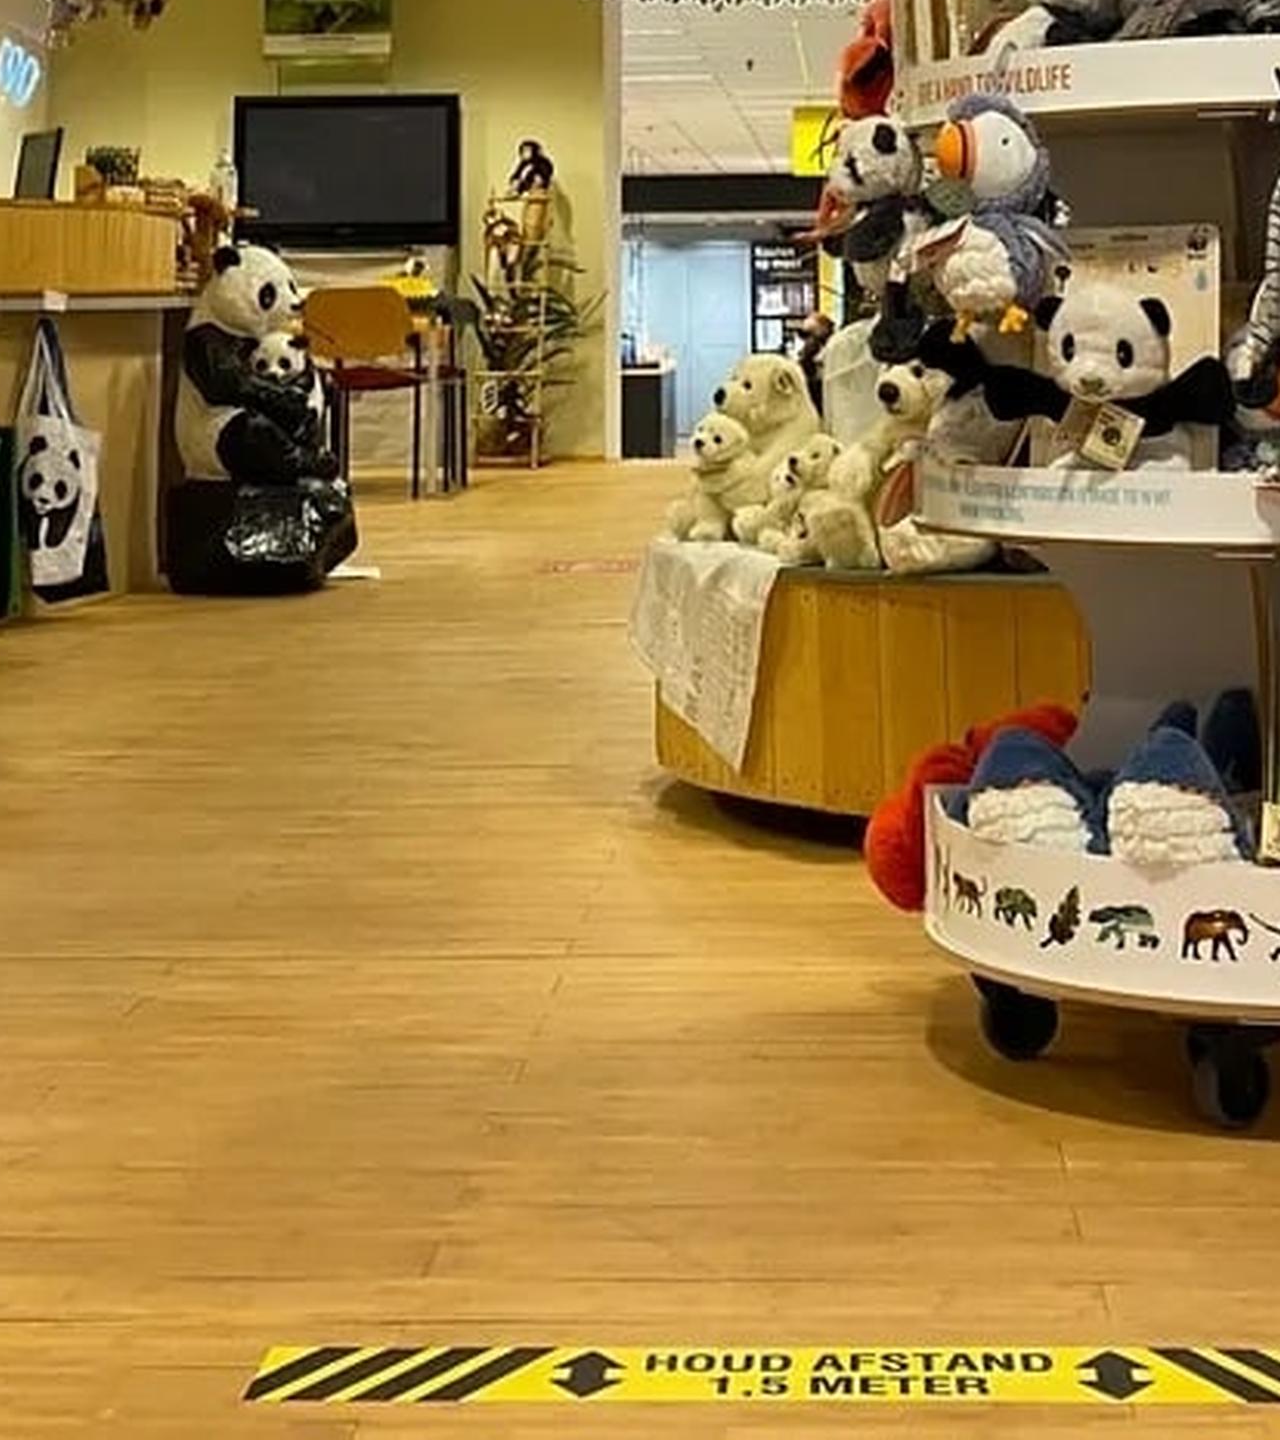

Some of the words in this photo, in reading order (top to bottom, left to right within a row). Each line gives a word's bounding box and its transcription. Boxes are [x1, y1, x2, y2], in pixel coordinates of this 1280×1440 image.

[644, 1350, 794, 1374] HOUD
[812, 1350, 1055, 1374] AFSTAND
[709, 1374, 790, 1397] 1.5
[809, 1374, 992, 1397] METER
